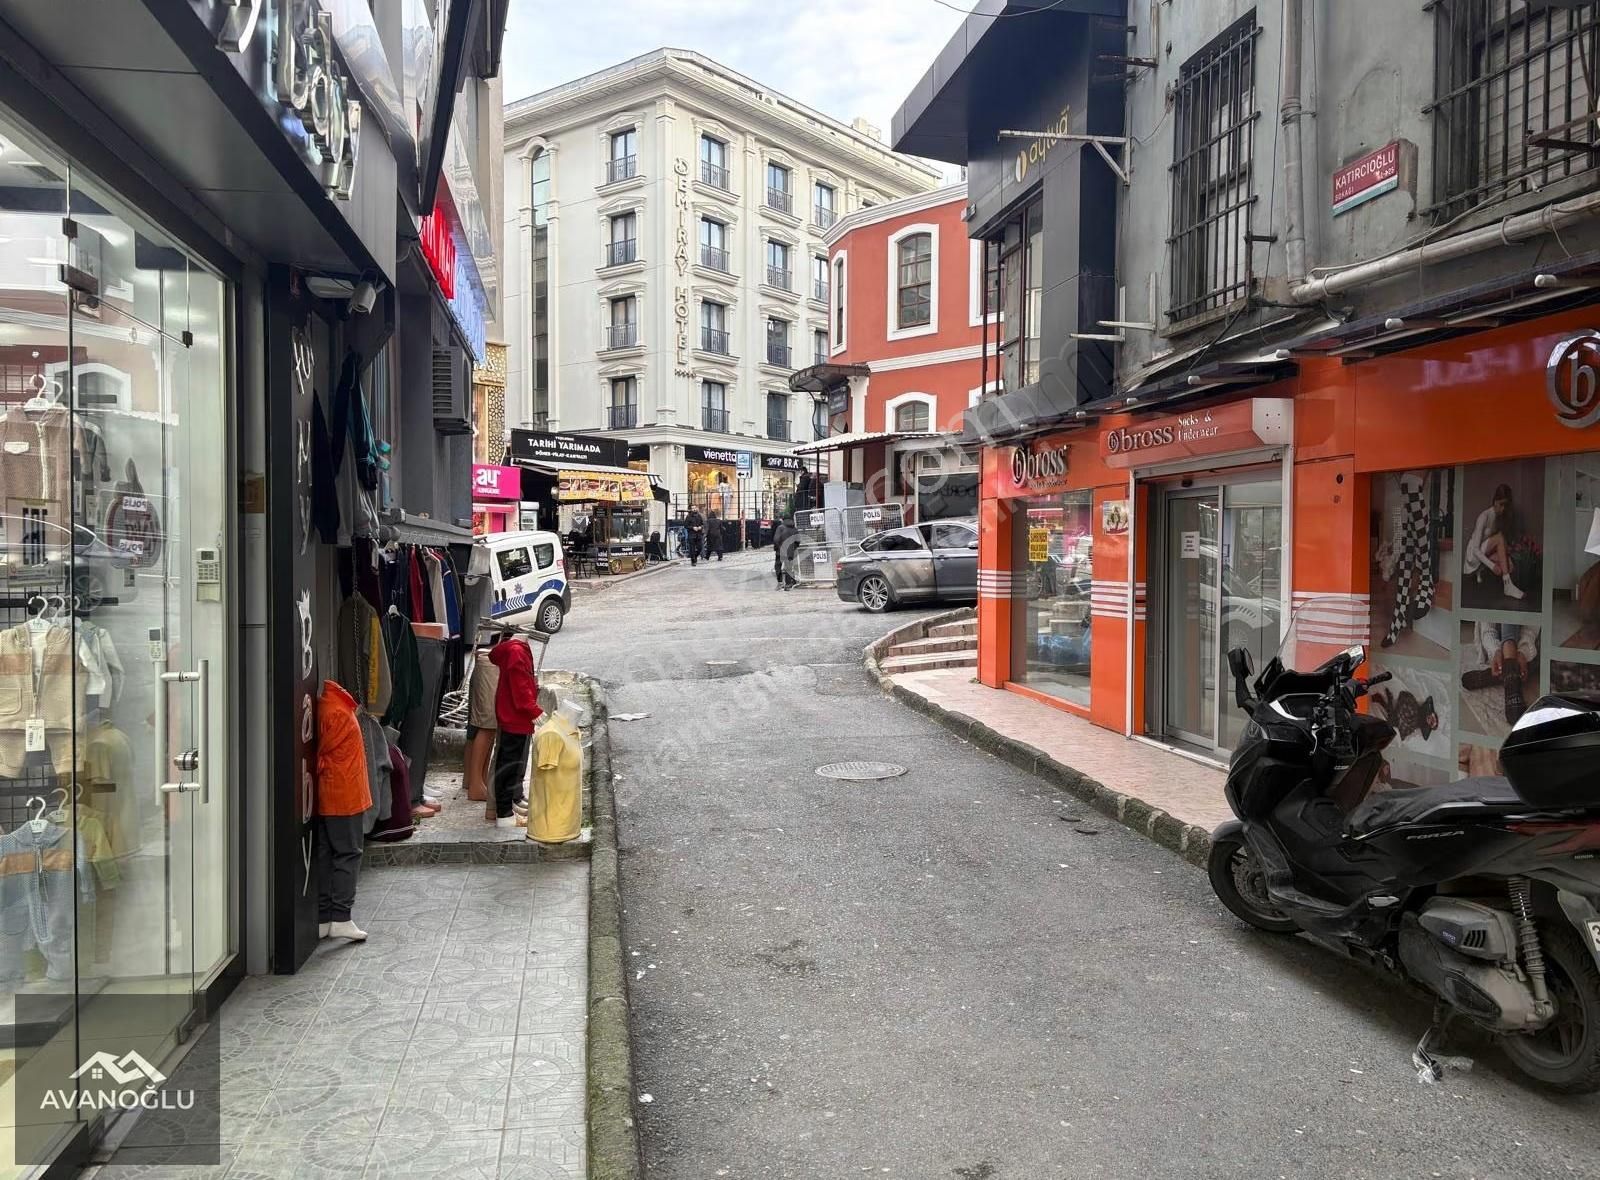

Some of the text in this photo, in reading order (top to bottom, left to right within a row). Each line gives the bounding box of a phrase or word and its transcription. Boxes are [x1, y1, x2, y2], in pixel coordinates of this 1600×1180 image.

[675, 286, 689, 365] HOTEL
[1178, 414, 1199, 427] Socks
[1121, 426, 1175, 451] bross
[1178, 426, 1219, 442] Underwear
[528, 438, 557, 449] TARİHİ
[558, 441, 601, 454] YARIMADA
[1027, 445, 1066, 480] bross
